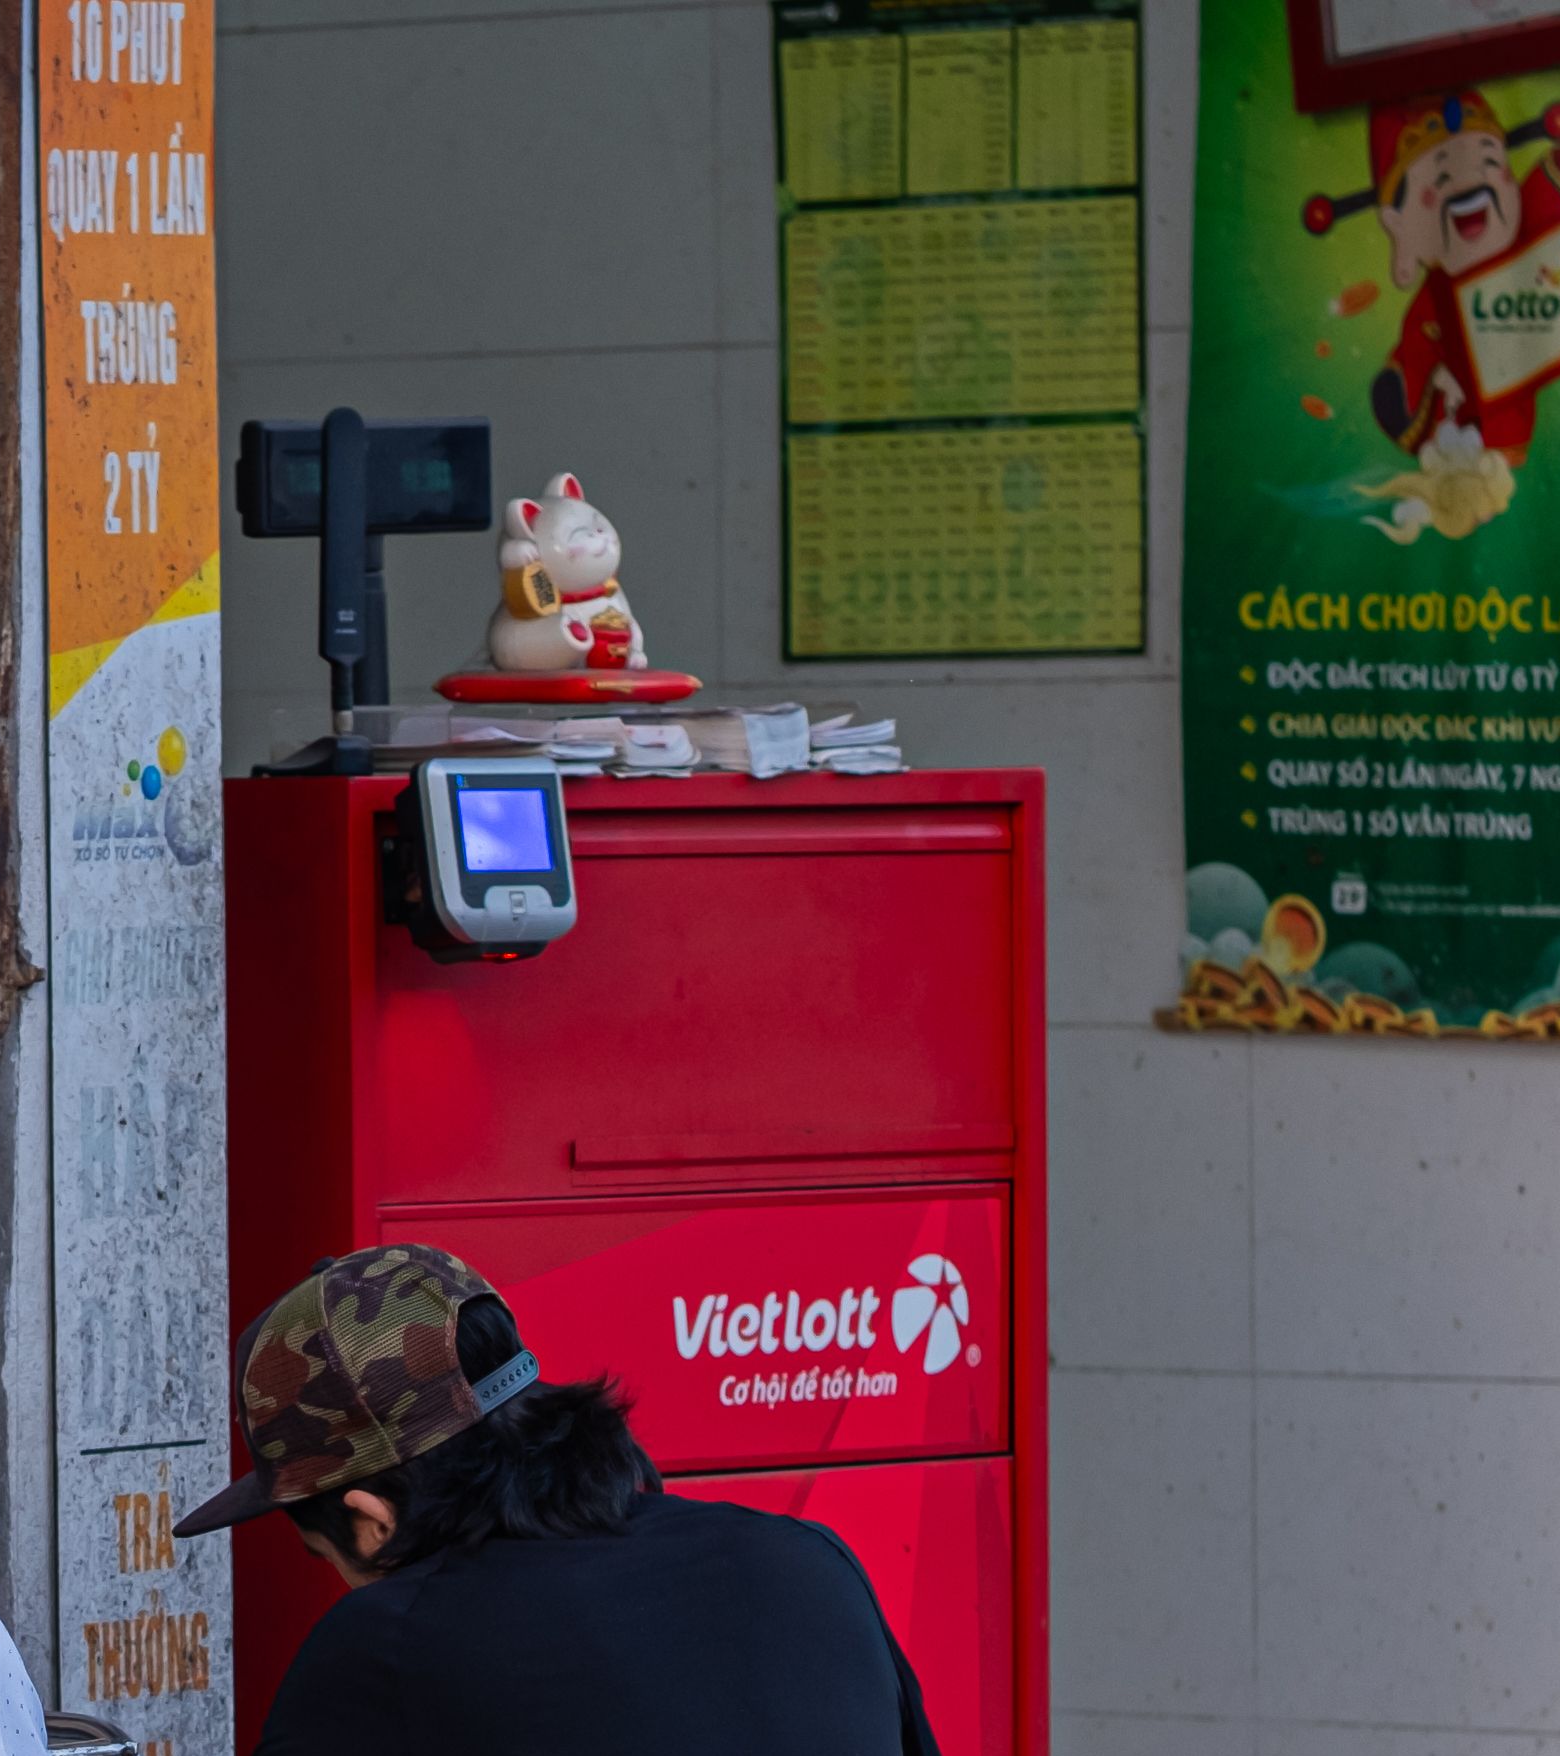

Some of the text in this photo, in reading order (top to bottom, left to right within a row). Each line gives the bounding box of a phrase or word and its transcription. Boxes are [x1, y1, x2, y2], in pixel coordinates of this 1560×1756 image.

[68, 0, 102, 83] 10
[47, 148, 118, 242] QUAY
[126, 152, 138, 234] 1
[80, 283, 178, 385] TRÚNG
[1471, 287, 1560, 320] Lotto
[103, 422, 160, 534] 2 TỶ
[1238, 584, 1349, 631] CÁCH
[1358, 590, 1446, 631] CHƠI
[1454, 586, 1533, 643] ĐỘC
[1512, 764, 1526, 790] 7
[672, 1285, 881, 1361] Vietlott
[719, 1365, 898, 1410] Cơ hội để tốt hơn
[114, 1460, 175, 1574] TRẢ
[83, 1587, 210, 1703] THƯỞNG
